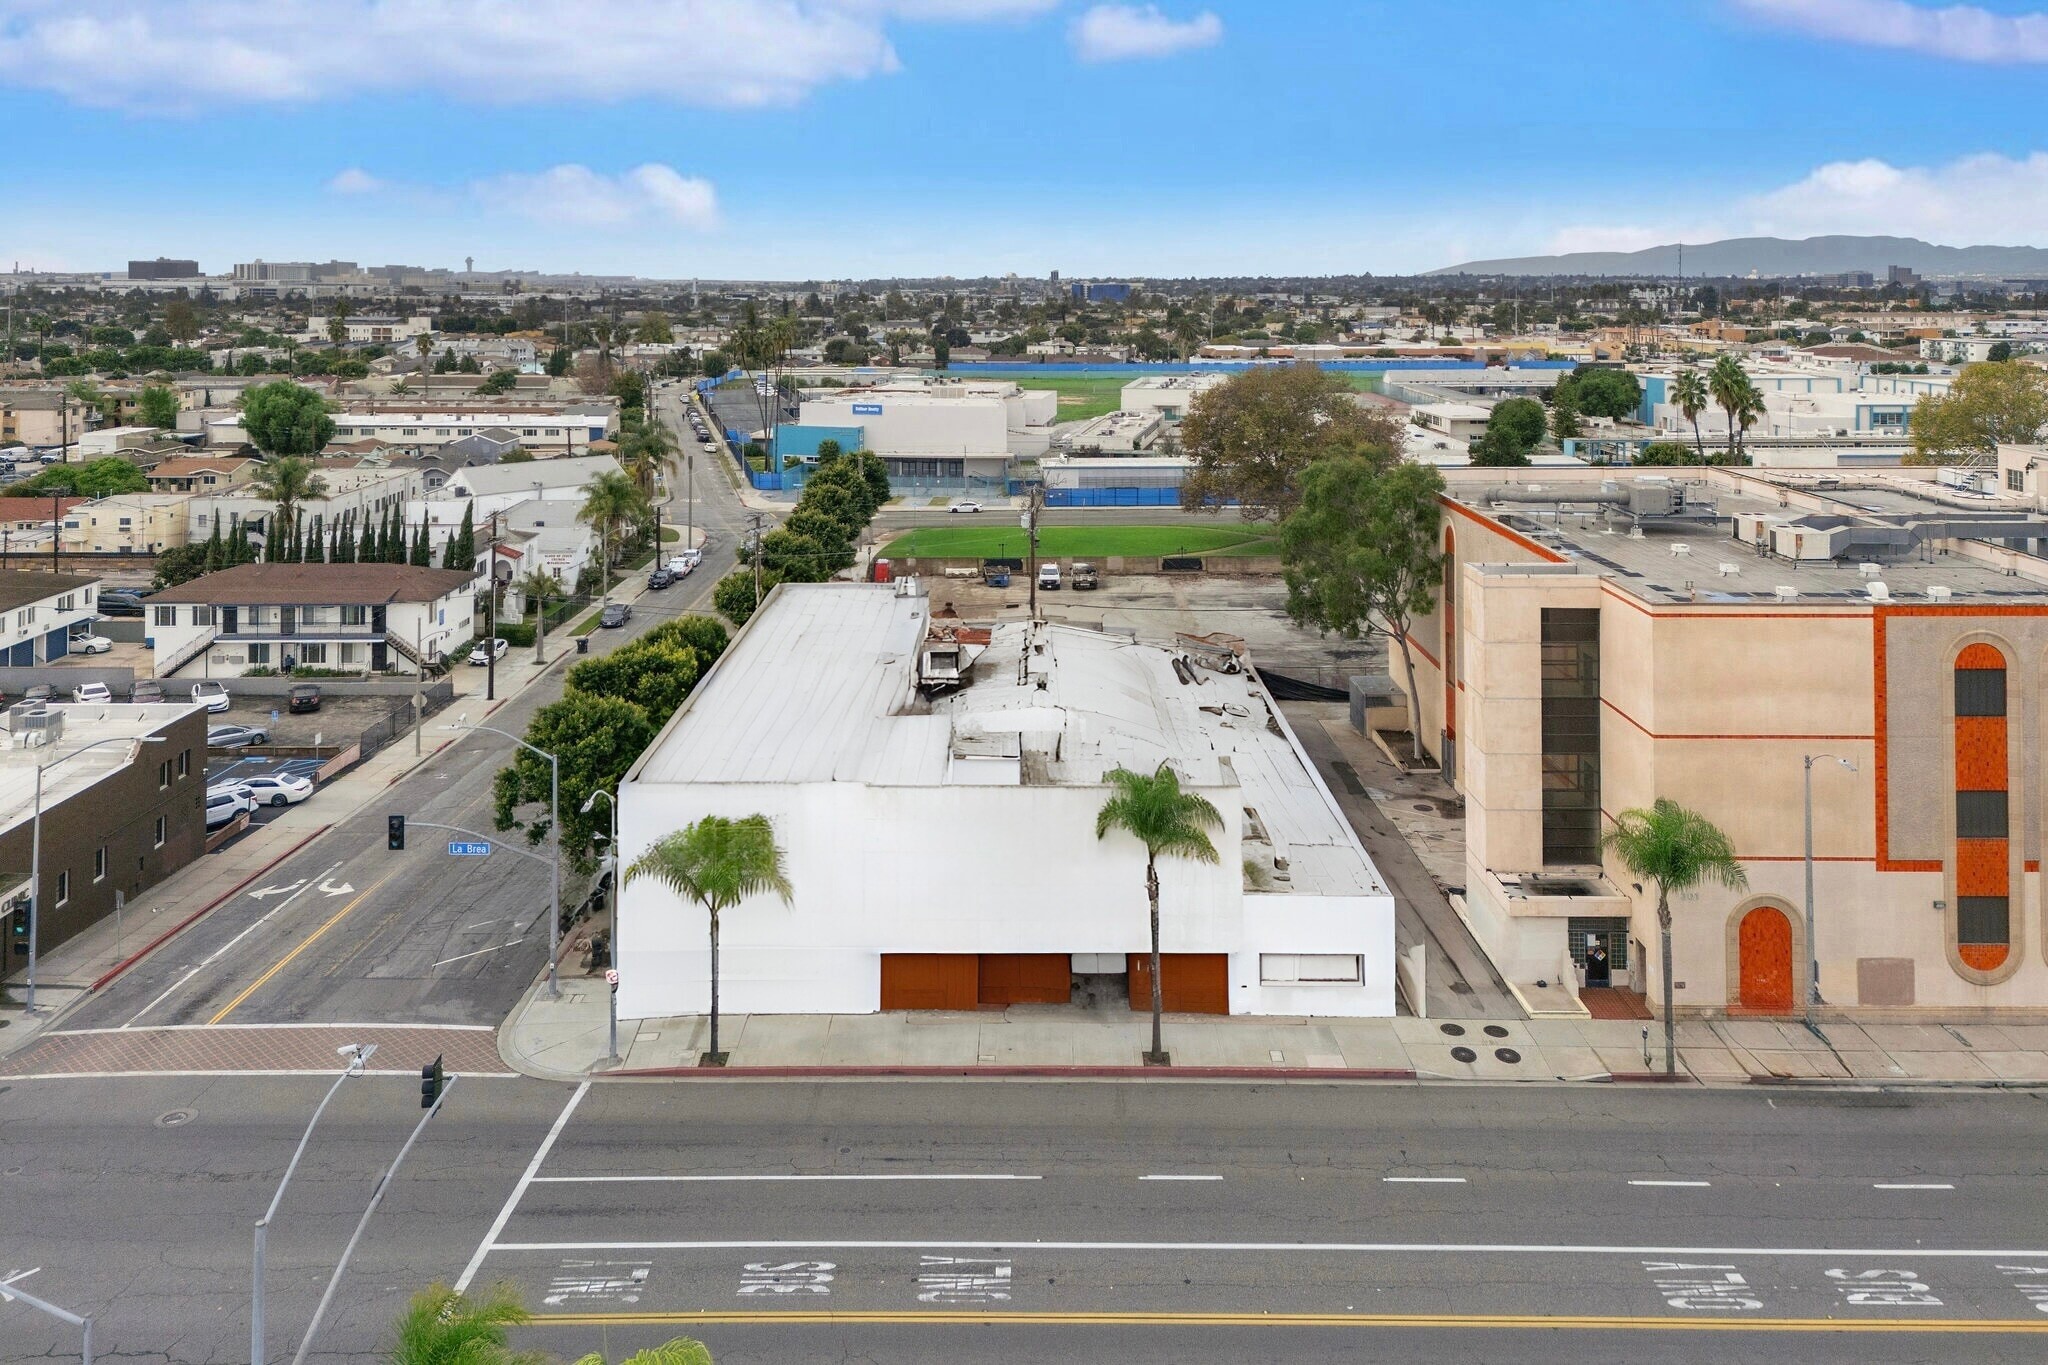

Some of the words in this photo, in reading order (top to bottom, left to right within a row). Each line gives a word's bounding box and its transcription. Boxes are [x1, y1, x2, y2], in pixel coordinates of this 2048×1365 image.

[452, 844, 462, 853] La
[467, 844, 486, 853] Brea
[736, 1261, 837, 1297] BUS
[916, 1255, 1012, 1303] ONLY
[1641, 1260, 1763, 1310] ONLY
[1824, 1268, 1944, 1306] BUS
